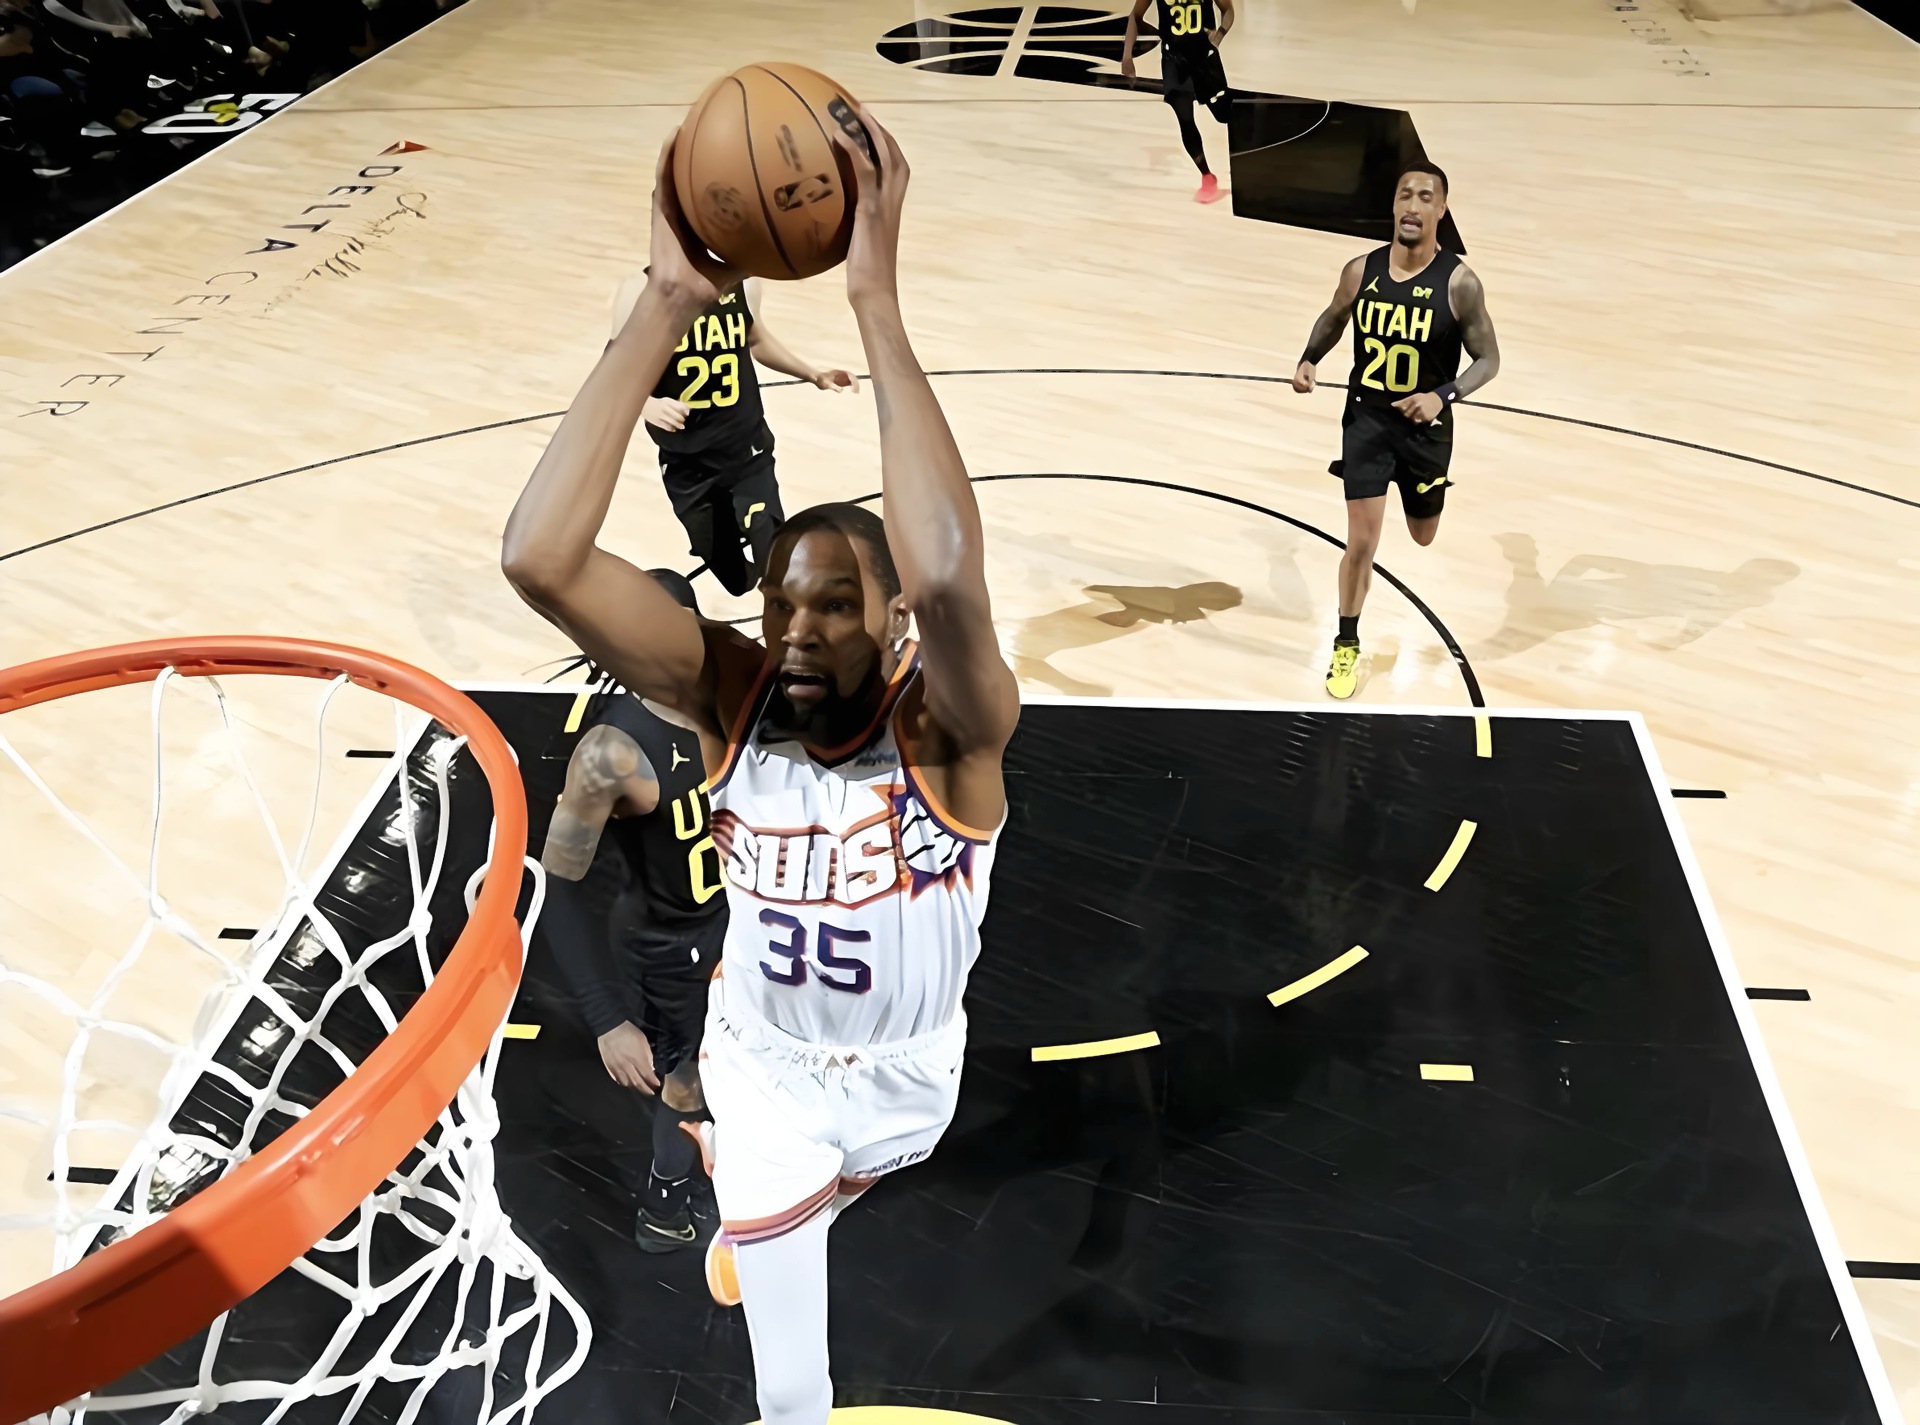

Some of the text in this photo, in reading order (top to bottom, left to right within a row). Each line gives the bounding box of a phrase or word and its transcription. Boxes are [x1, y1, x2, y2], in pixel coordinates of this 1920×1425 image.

[1170, 5, 1202, 36] 30
[244, 165, 404, 256] DELTA
[17, 271, 259, 418] CENTER
[1356, 298, 1434, 342] UTAH
[676, 353, 740, 409] 23
[1360, 337, 1420, 393] 20
[724, 815, 902, 904] SUNS
[758, 907, 872, 995] 35
